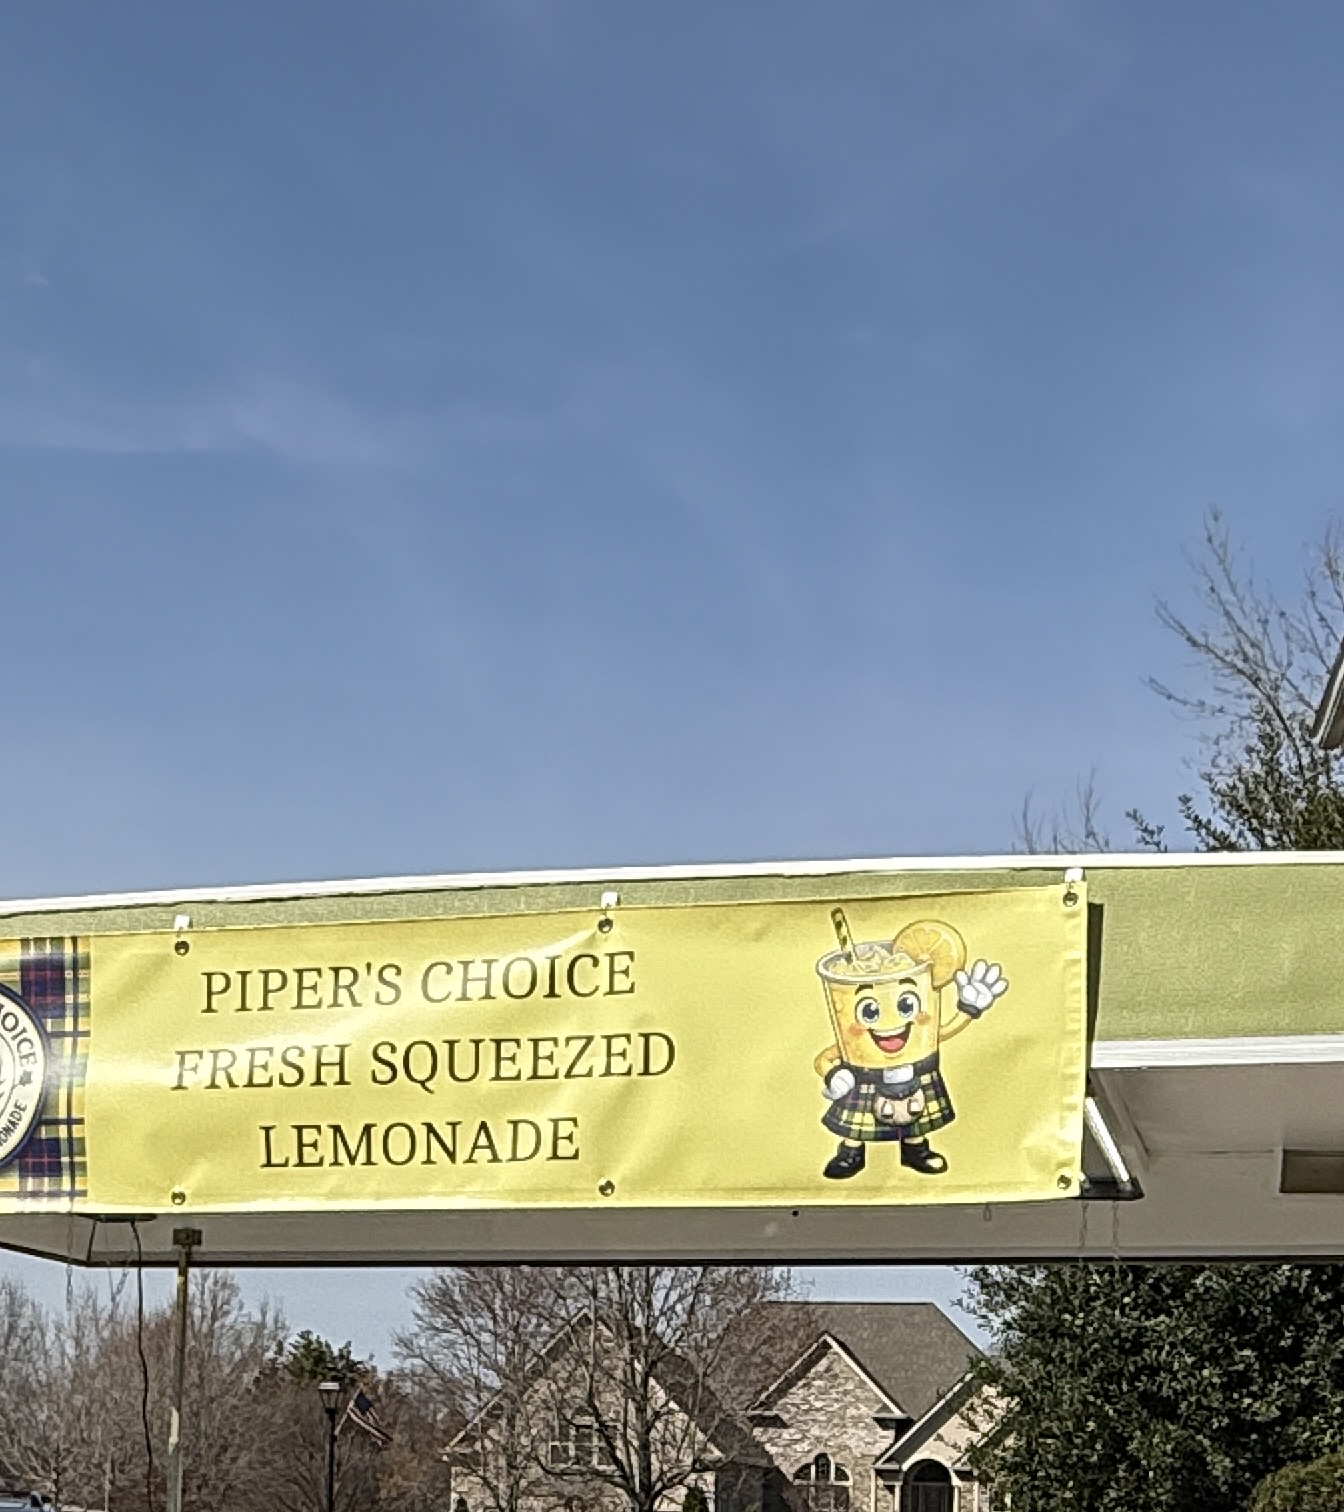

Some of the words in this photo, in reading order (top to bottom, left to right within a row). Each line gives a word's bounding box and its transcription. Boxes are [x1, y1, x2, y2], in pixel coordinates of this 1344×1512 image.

[200, 962, 403, 1014] PIPER'S
[421, 950, 637, 1004] CHOICE
[171, 1042, 352, 1091] FRESH
[370, 1032, 677, 1094] SQUEEZED
[258, 1117, 581, 1169] LEMONADE
